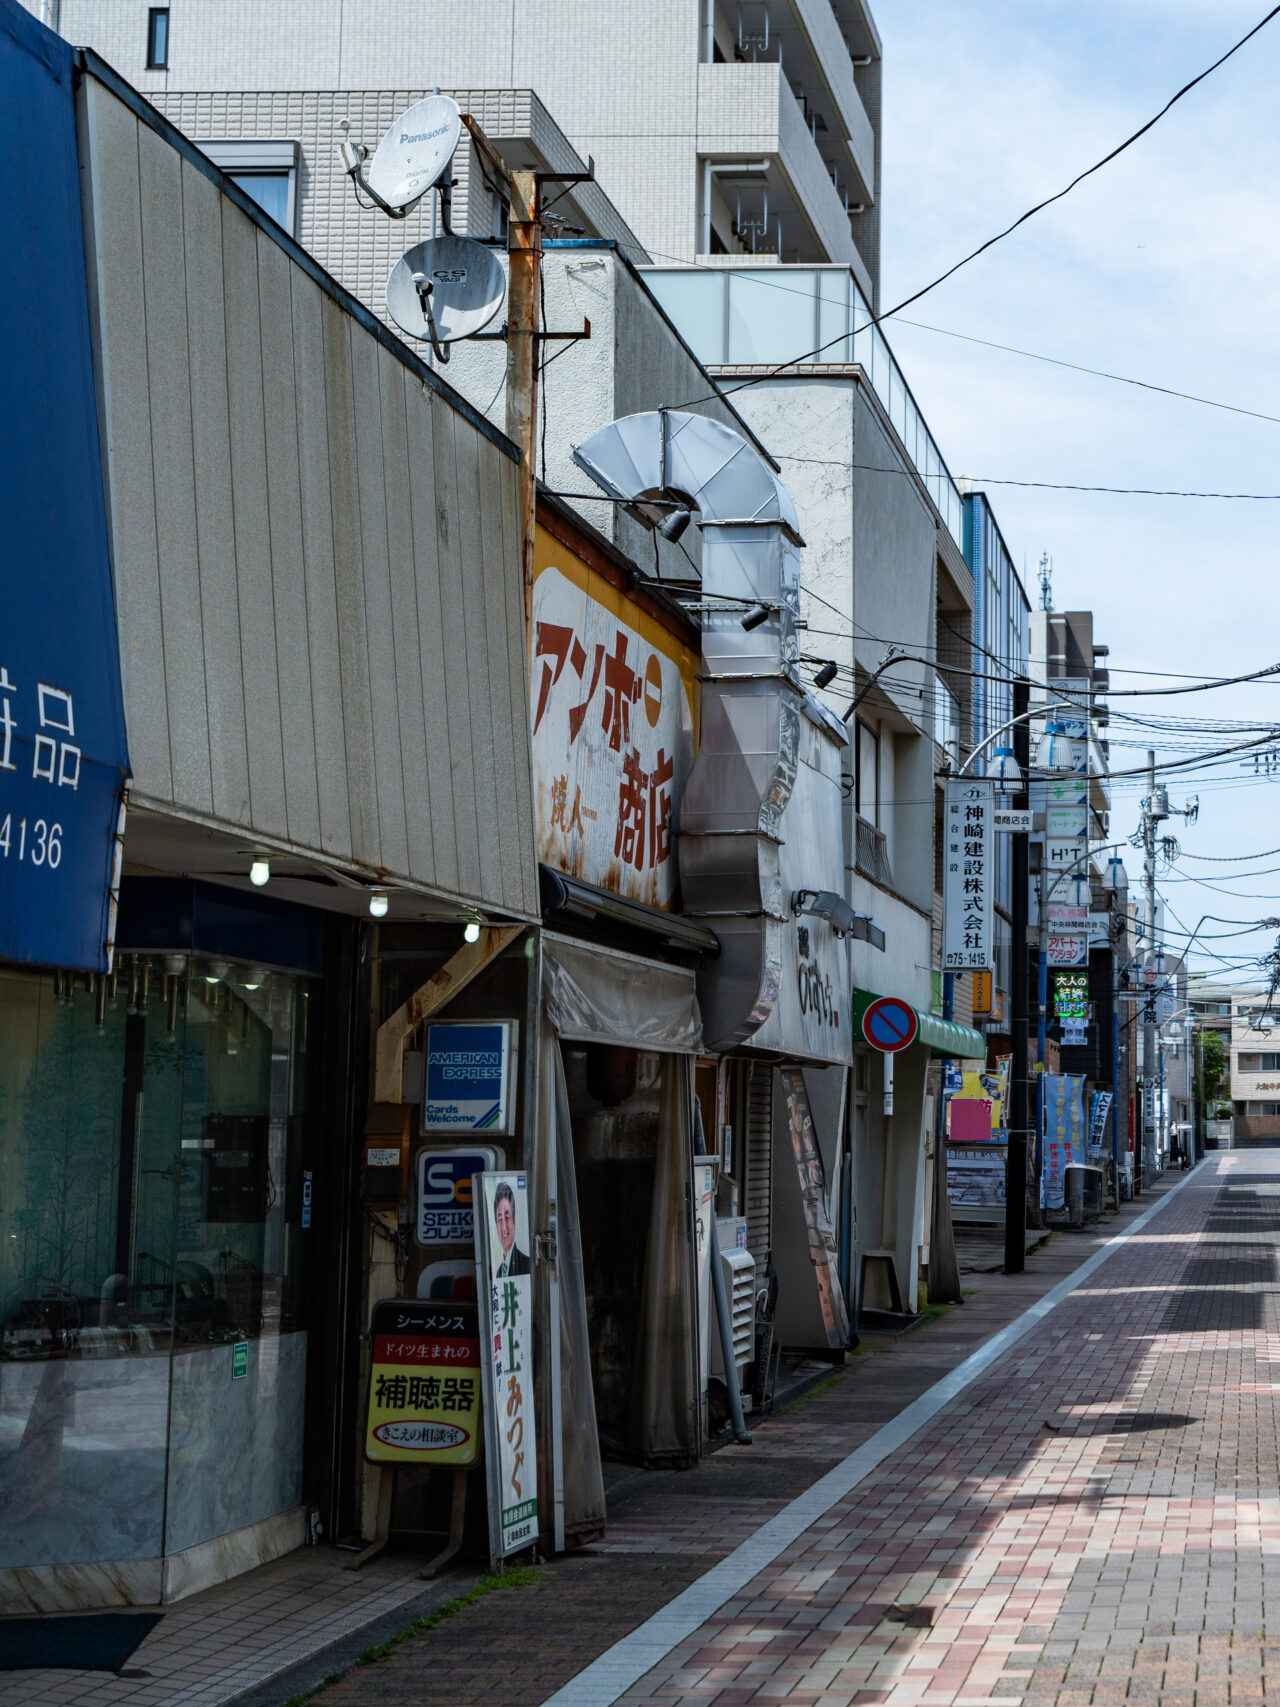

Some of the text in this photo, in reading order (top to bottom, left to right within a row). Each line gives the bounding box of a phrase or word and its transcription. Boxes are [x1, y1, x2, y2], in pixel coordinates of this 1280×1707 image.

[400, 122, 450, 145] Panasonic
[432, 269, 467, 278] CS
[614, 747, 674, 873] 商店
[963, 804, 985, 950] 神崎建設株式会社
[1051, 920, 1098, 929] 中央林間商店会
[953, 952, 986, 966] 75-1415
[1056, 975, 1087, 987] 大人の
[429, 1052, 499, 1065] AMERICAN
[443, 1067, 503, 1080] EXPRESS
[426, 1104, 459, 1115] Cards
[426, 1113, 476, 1124] Welcome
[423, 1211, 474, 1227] SEIK
[396, 1314, 465, 1331] シーメンス
[385, 1342, 471, 1360] ドイツ生まれの
[374, 1373, 475, 1413] 補聴器
[381, 1425, 460, 1445] きこえの相談室
